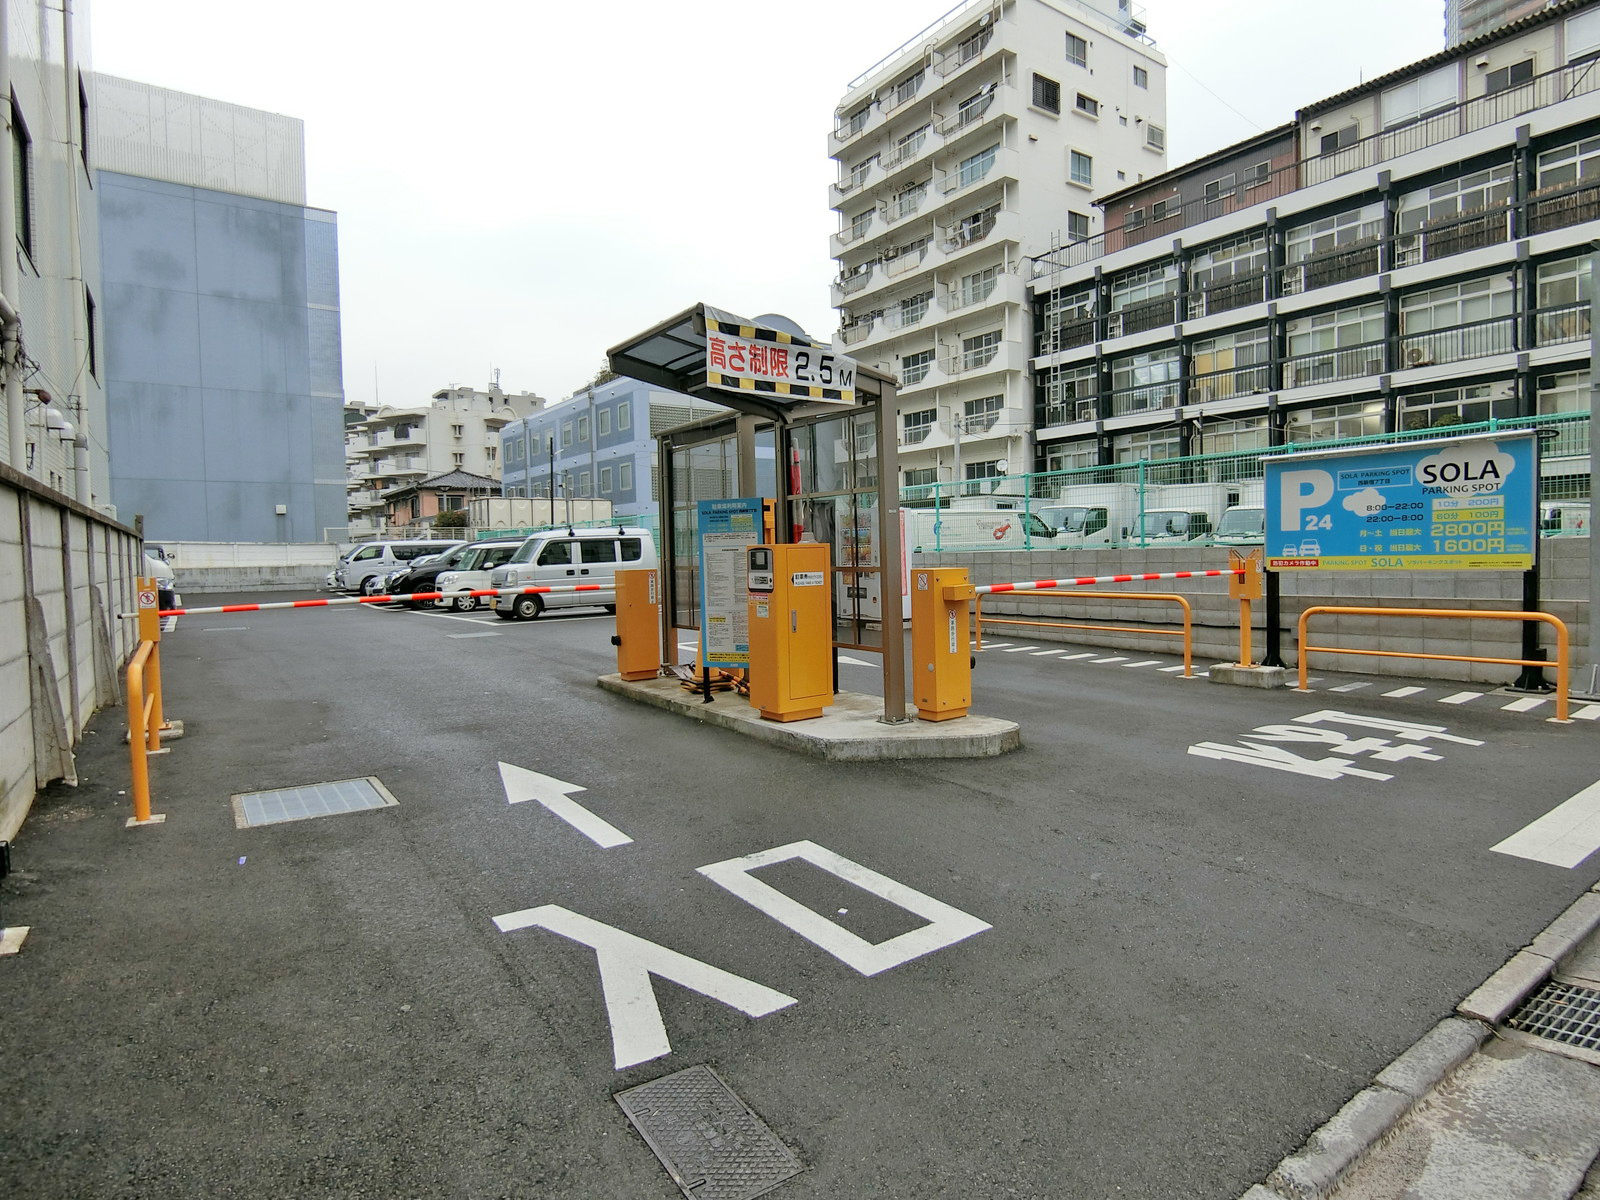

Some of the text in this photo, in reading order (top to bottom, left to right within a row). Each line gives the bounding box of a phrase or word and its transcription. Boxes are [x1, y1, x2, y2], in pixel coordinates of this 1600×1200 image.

[708, 336, 789, 378] 高さ制限
[1423, 460, 1500, 484] SOLA
[1422, 482, 1500, 495] PARKING SPOT
[1281, 470, 1334, 532] P
[1468, 498, 1499, 506] 200円
[1305, 514, 1332, 531] 24
[1431, 521, 1504, 536] 2800円
[1433, 538, 1504, 553] 1600円
[1371, 558, 1403, 567] SOLA
[1187, 710, 1485, 782] 止まれ
[491, 840, 993, 1070] 入口
